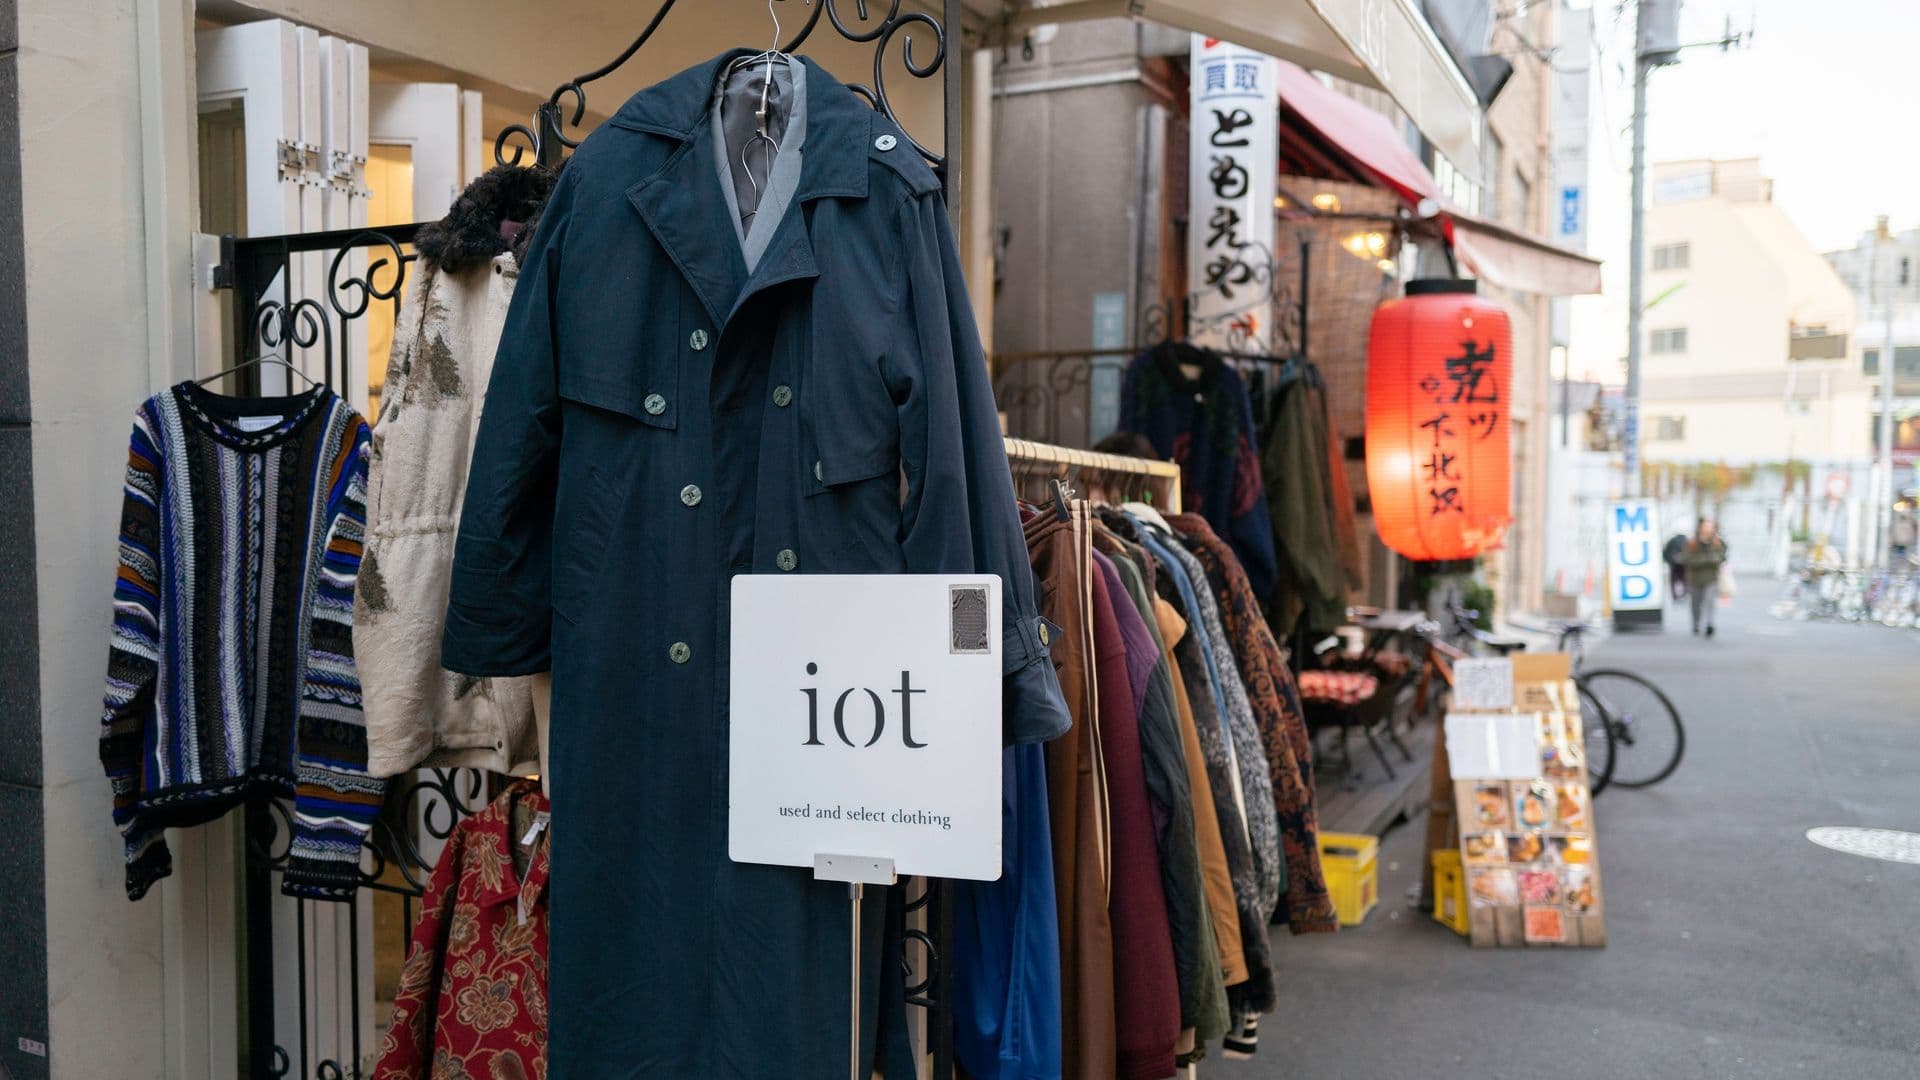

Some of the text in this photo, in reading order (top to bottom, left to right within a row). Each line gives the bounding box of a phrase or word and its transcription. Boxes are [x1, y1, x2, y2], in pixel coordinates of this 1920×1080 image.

[1206, 64, 1258, 91] 買取
[1616, 507, 1652, 600] MUD
[800, 662, 929, 749] iot
[779, 803, 951, 830] used and select clothing
